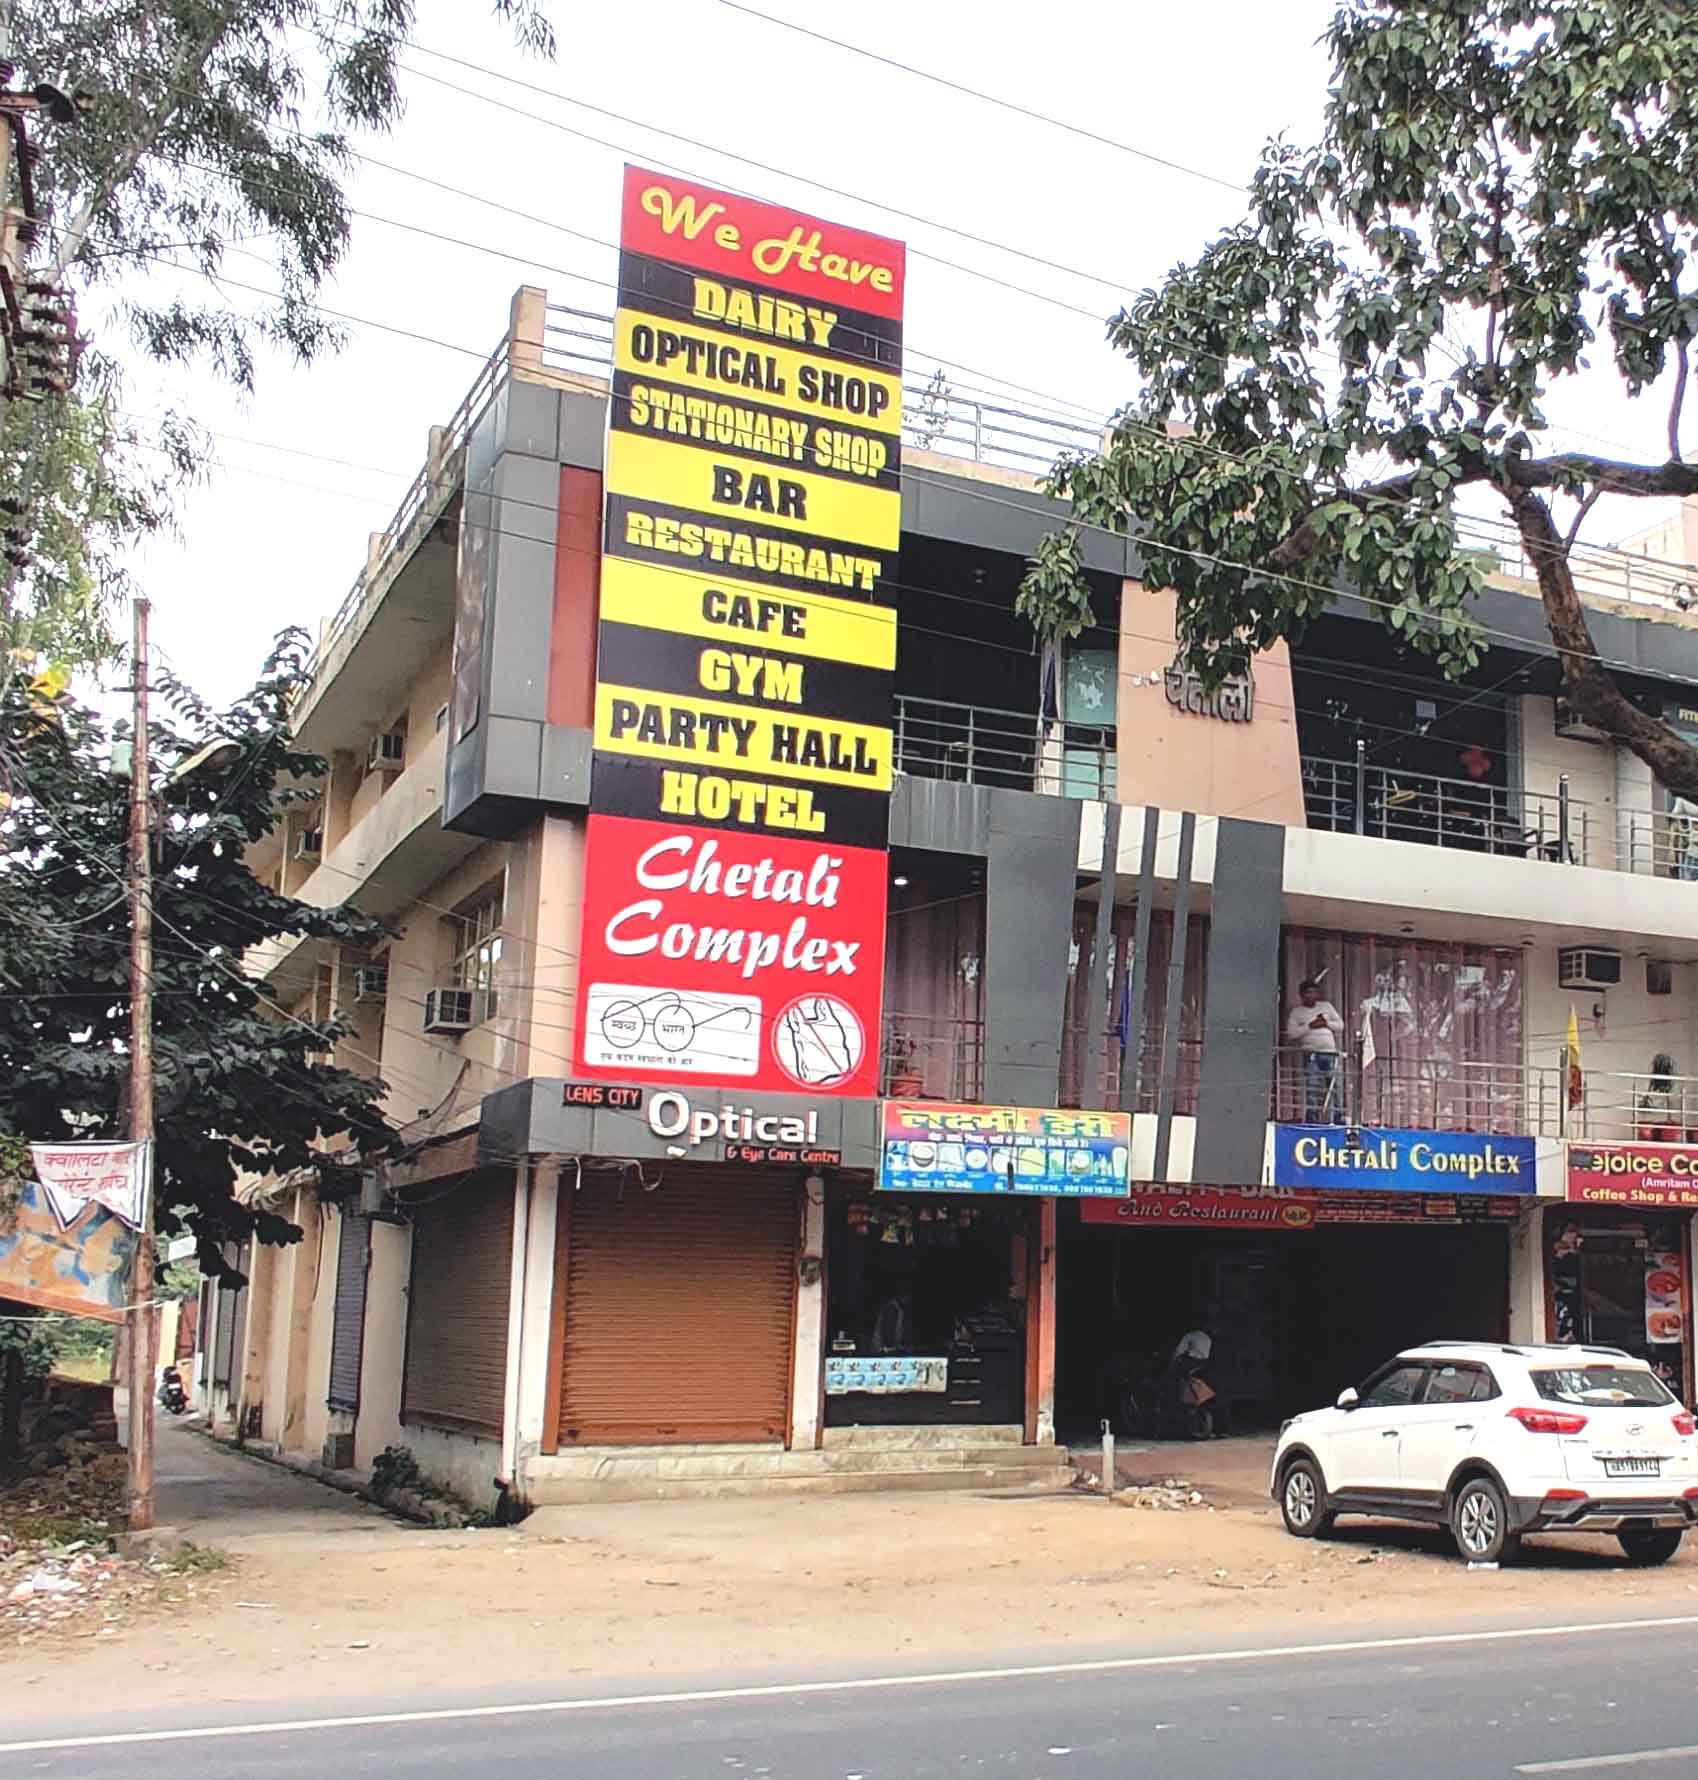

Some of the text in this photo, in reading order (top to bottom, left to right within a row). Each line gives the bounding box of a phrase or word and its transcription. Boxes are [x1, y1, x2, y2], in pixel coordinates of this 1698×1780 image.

[641, 186, 894, 293] We Have
[692, 277, 838, 348] DAIRY
[630, 324, 890, 419] OPTICAL SHOP
[629, 383, 887, 478] STATIONARY SHOP
[712, 464, 808, 520] BAR
[625, 511, 882, 591] RESTAURANT
[701, 589, 808, 639] CAFE
[698, 648, 805, 705] GYM
[610, 698, 878, 777] PARTY HALL
[660, 768, 826, 832] HOTEL
[635, 835, 843, 908] Chetali
[604, 899, 861, 979] Complex
[566, 1085, 640, 1107] LENS CITY
[648, 1090, 818, 1146] Optical
[1574, 1151, 1663, 1177] ejoice
[1583, 1187, 1628, 1201] Coffee
[1630, 1187, 1665, 1204] Shop
[1668, 1190, 1677, 1202] &
